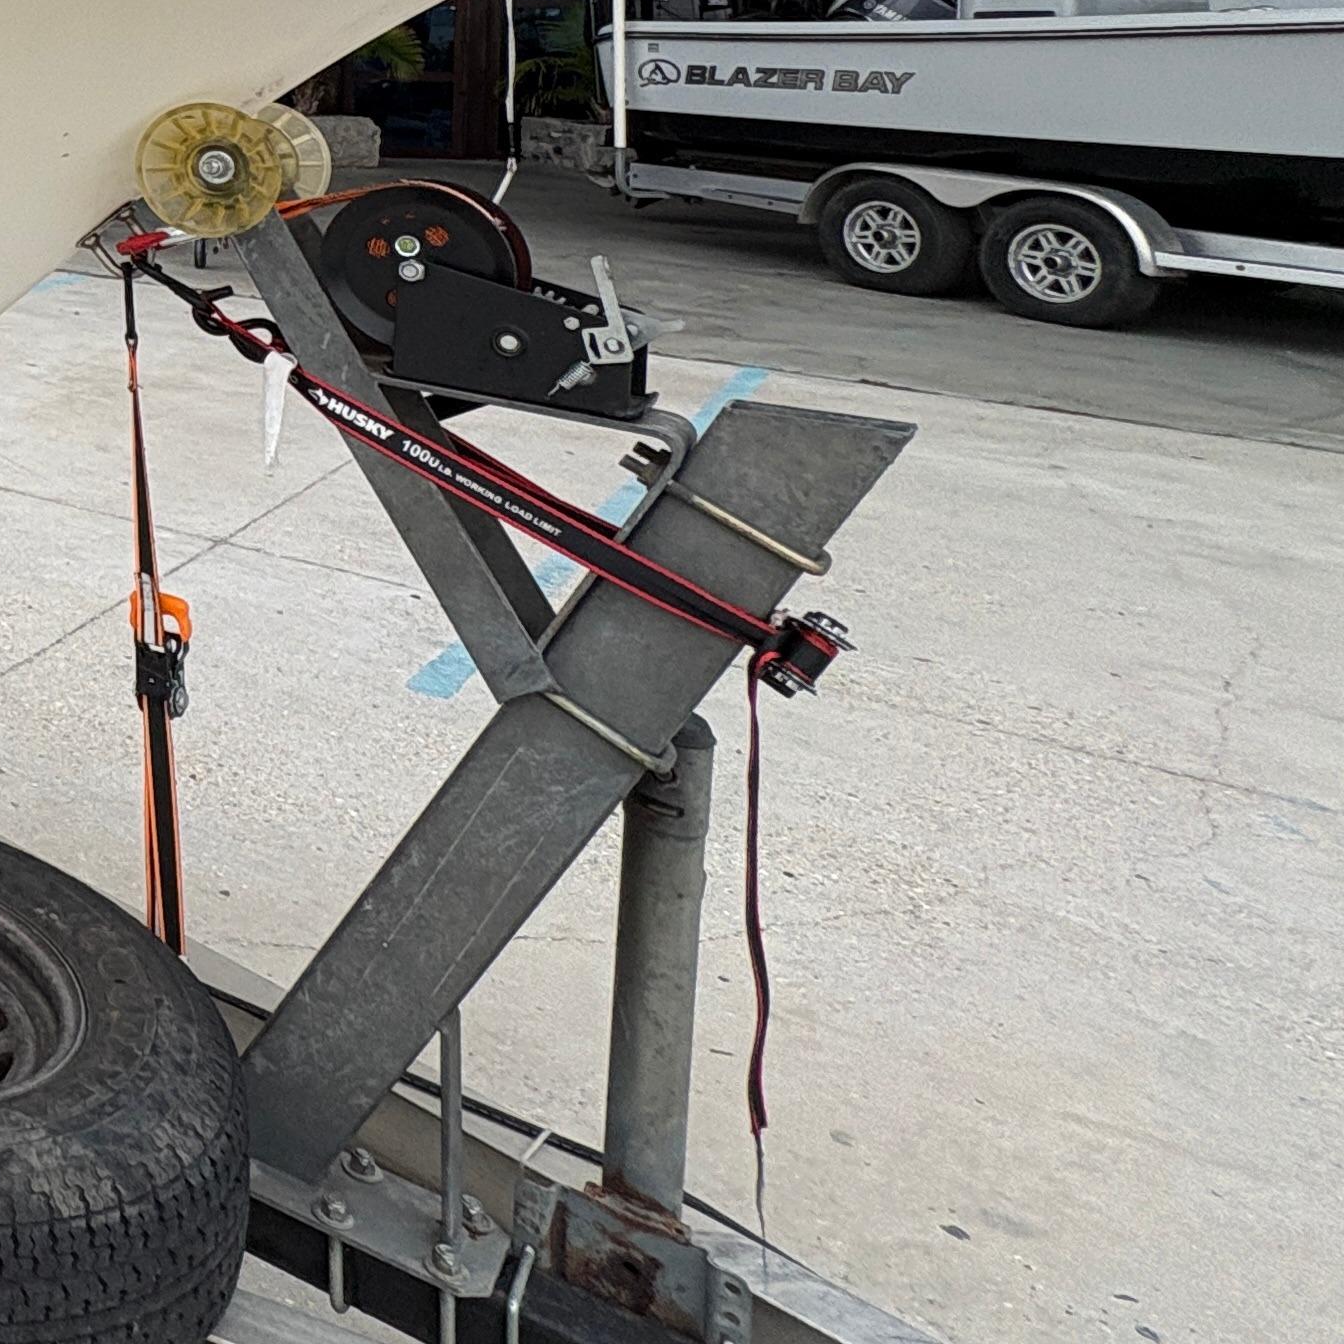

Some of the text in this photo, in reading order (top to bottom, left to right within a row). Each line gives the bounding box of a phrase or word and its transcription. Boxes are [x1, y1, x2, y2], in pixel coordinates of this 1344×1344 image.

[685, 65, 915, 94] BLAZER BAY
[327, 398, 395, 440] HUSKY
[455, 474, 502, 504] WORKING
[505, 501, 533, 521] LOAD
[533, 517, 562, 536] LIMIT
